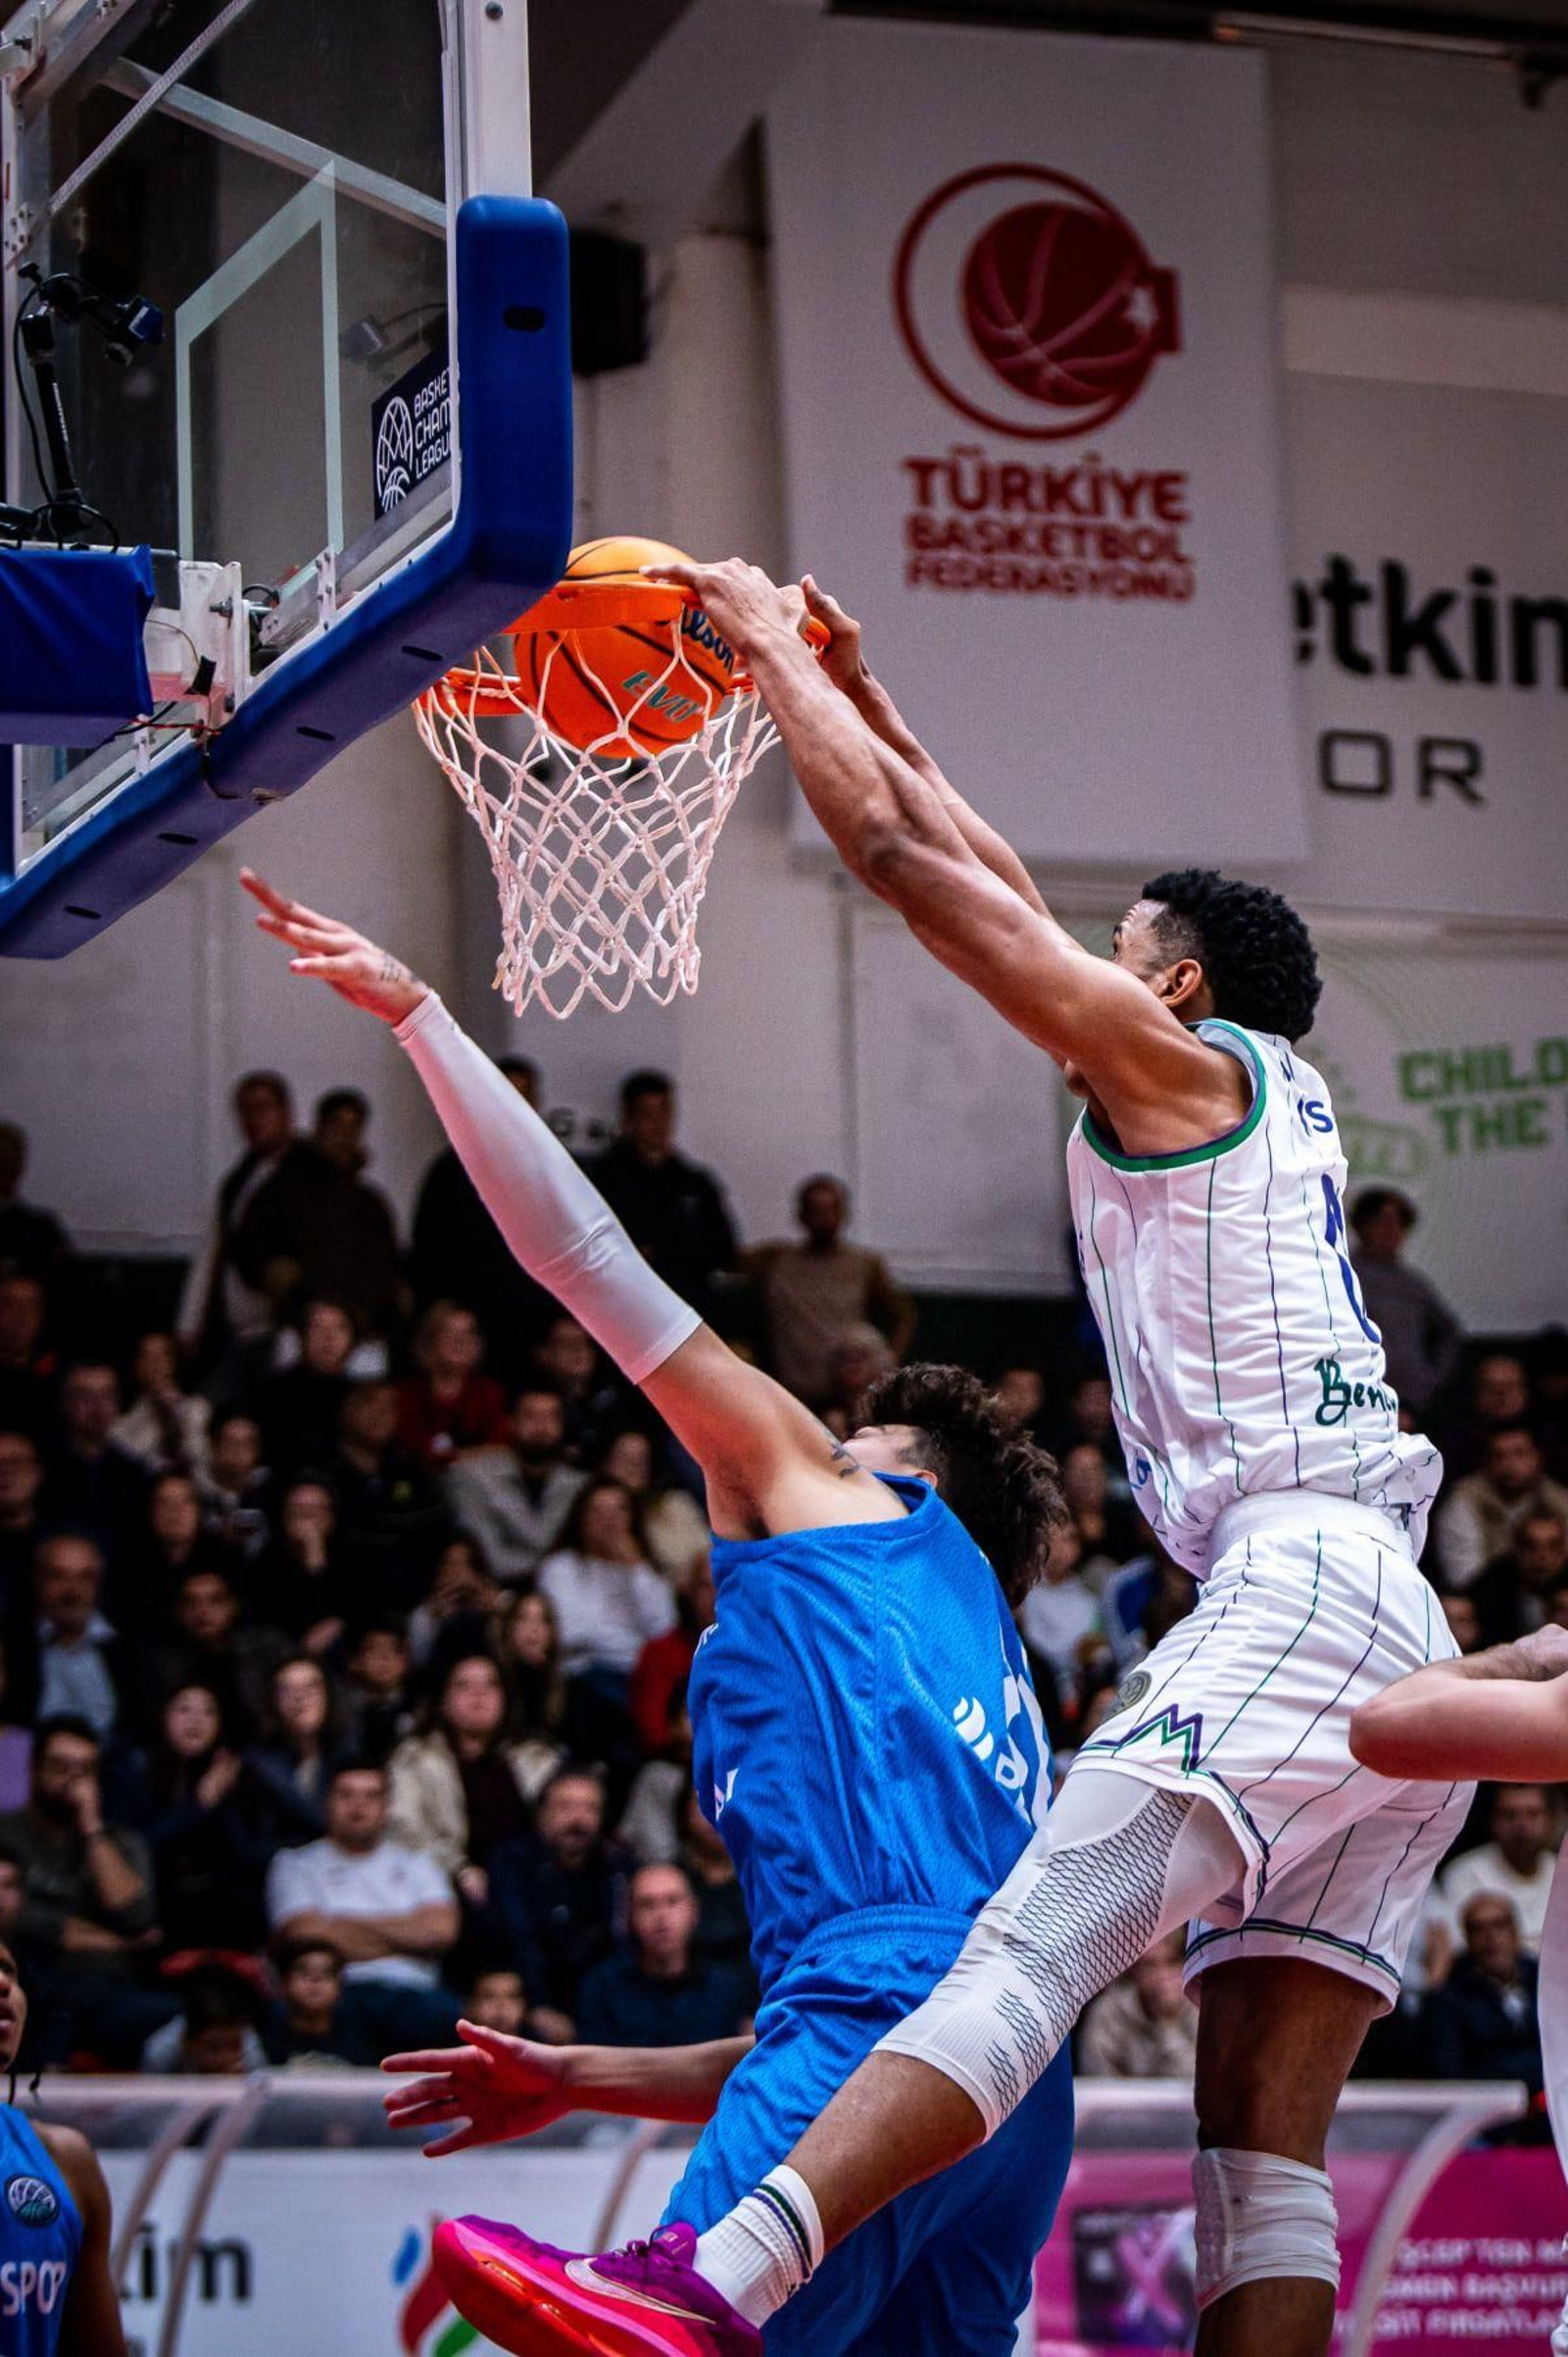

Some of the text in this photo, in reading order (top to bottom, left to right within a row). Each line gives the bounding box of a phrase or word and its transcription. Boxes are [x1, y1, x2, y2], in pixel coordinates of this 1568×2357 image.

[901, 445, 1192, 523] TÜRKİYE
[906, 514, 1192, 565] BASKETBOL
[1434, 1097, 1548, 1154] THE
